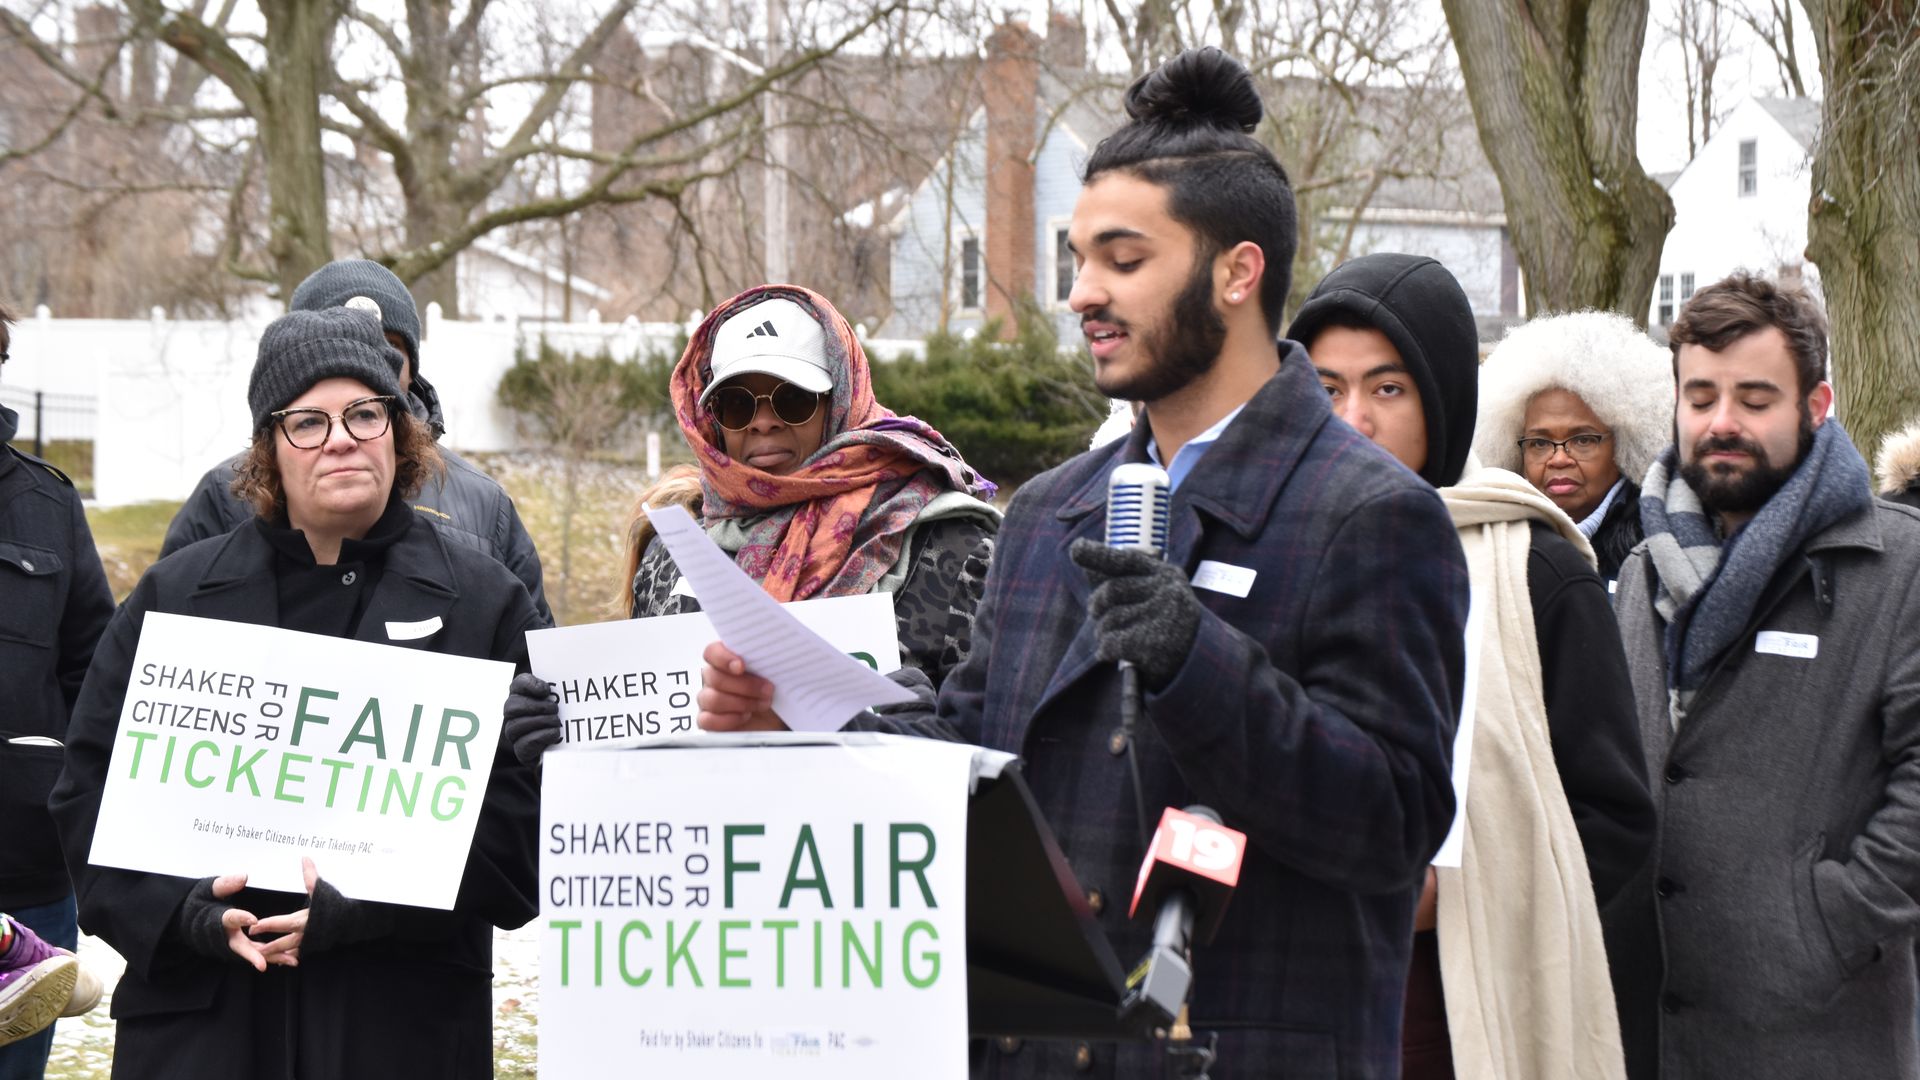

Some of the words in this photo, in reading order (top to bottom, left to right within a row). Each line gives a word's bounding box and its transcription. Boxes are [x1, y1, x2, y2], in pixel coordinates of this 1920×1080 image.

[140, 662, 255, 699] SHAKER
[546, 671, 658, 704] SHAKER
[667, 670, 692, 734] FOR
[131, 699, 247, 736] CITIZENS
[254, 681, 288, 742] FOR
[289, 686, 481, 770] FAIR
[558, 710, 661, 745] ITIZENS
[126, 730, 467, 822] TICKETING
[193, 818, 210, 832] Paid
[212, 821, 223, 834] for
[225, 824, 234, 839] by
[236, 825, 263, 840] Shaker
[265, 829, 295, 845] Citizens
[297, 834, 309, 847] for
[310, 836, 326, 849] Fair
[357, 841, 374, 854] PAC
[550, 822, 673, 854] SHAKER
[1168, 818, 1237, 871] 19
[550, 875, 673, 908] CITIZENS
[684, 825, 710, 908] FOR
[723, 822, 939, 909] FAIR
[549, 919, 942, 990] TICKETING
